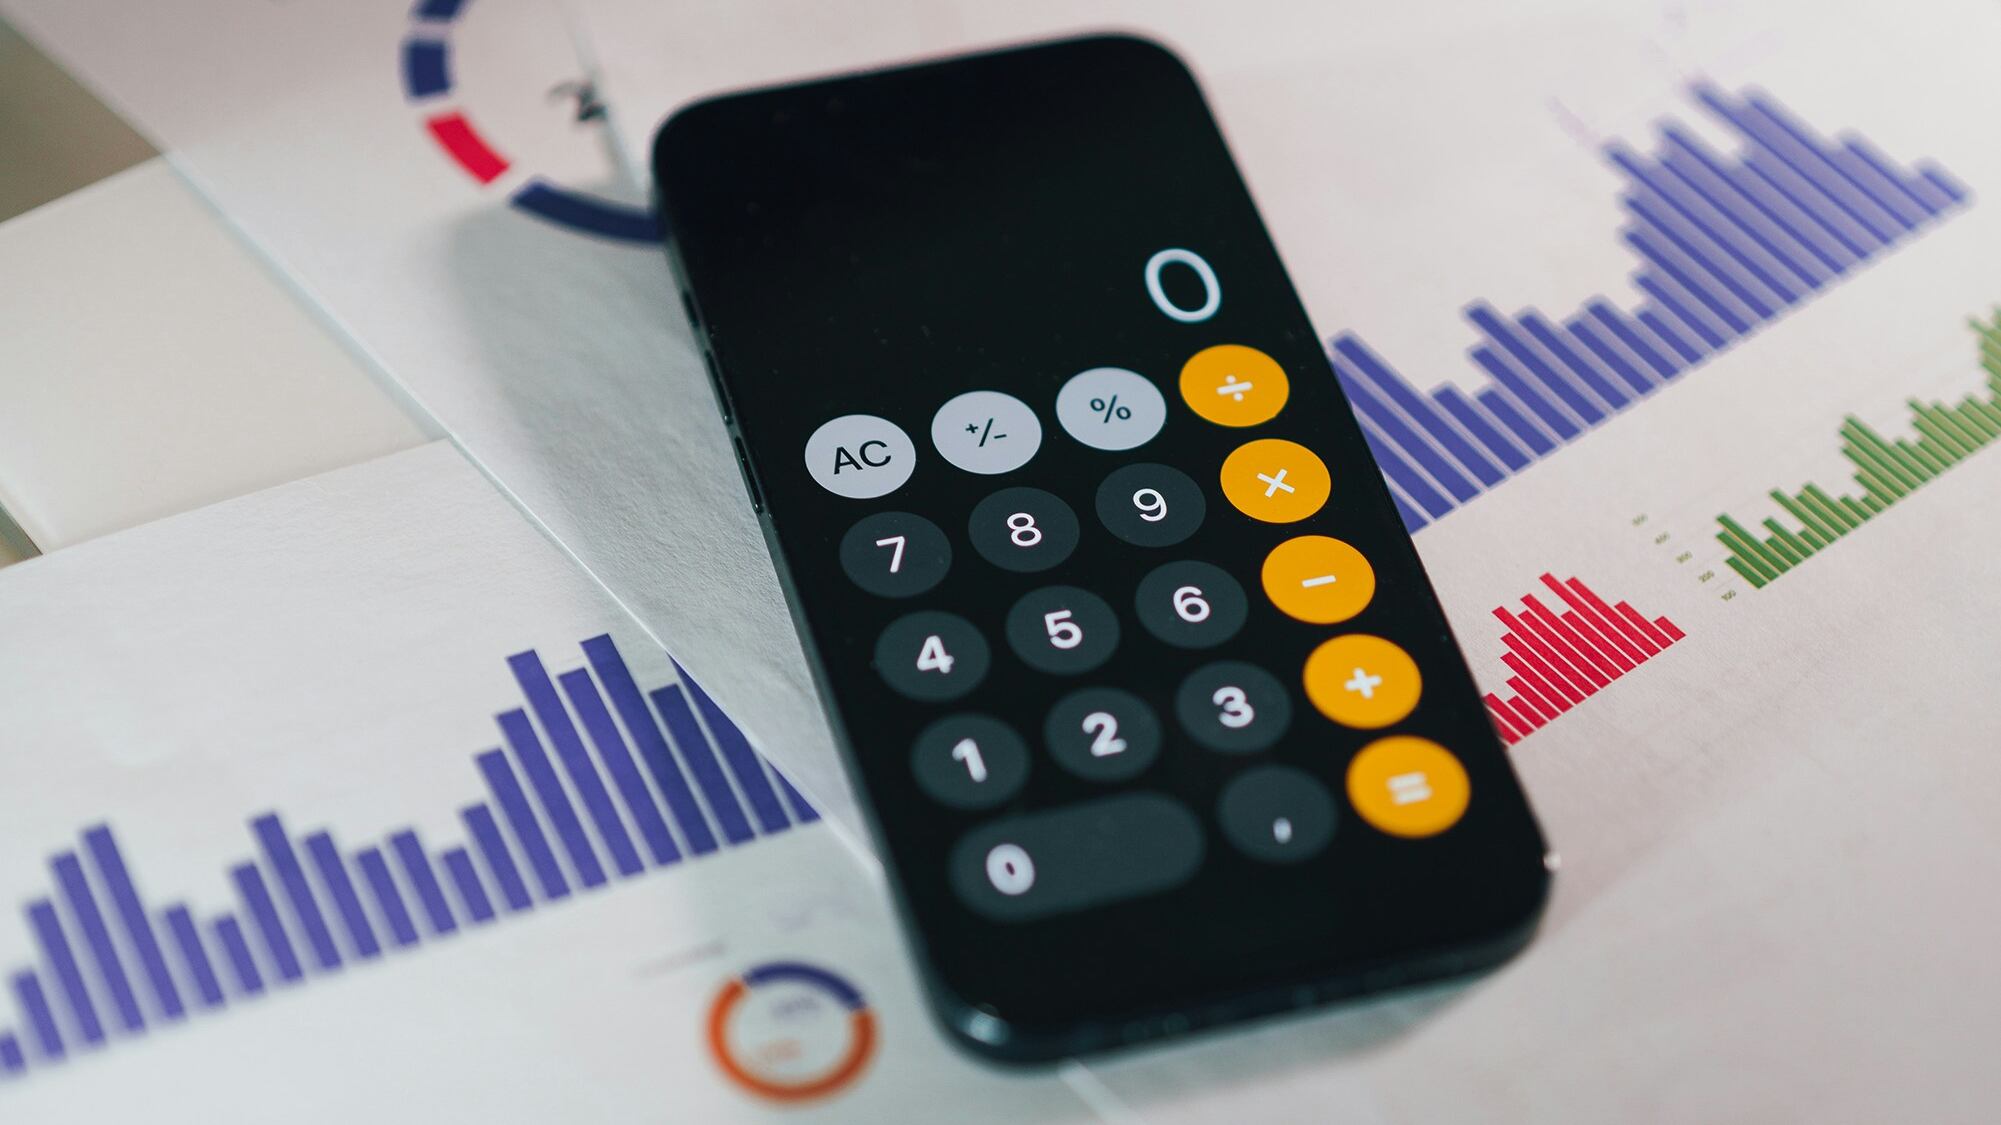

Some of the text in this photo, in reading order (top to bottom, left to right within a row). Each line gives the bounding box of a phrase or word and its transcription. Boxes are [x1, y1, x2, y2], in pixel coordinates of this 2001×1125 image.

[1144, 248, 1222, 323] 0
[833, 440, 892, 475] AC
[1089, 394, 1132, 423] %
[875, 535, 906, 573] 7
[1006, 512, 1042, 547] 8
[1132, 488, 1168, 522] 9
[916, 635, 954, 674] 4
[1044, 609, 1083, 649] 5
[1173, 586, 1211, 623] 6
[952, 667, 1382, 782] 1 2 3 +
[986, 844, 1035, 895] 0
[1387, 771, 1432, 805] =
